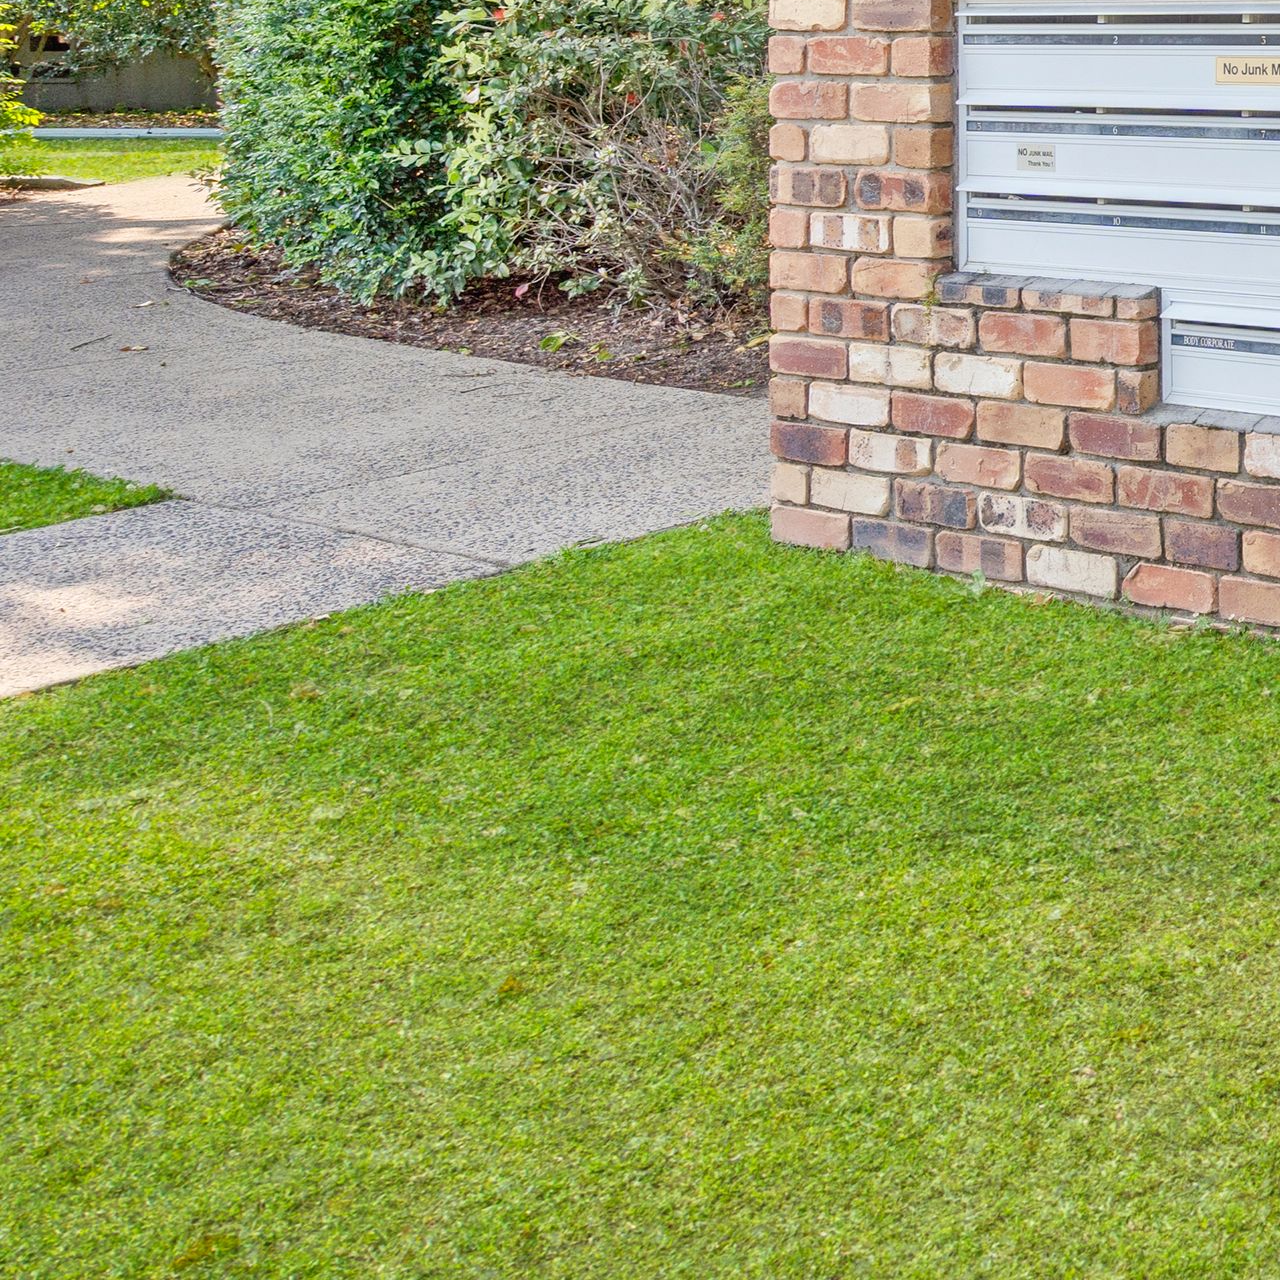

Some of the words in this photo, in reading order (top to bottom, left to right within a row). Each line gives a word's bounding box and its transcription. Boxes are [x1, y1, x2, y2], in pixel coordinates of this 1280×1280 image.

[1112, 35, 1119, 45] 2
[1260, 35, 1267, 45] 3
[1223, 62, 1239, 75] No
[1241, 62, 1268, 76] Junk
[1112, 127, 1118, 135] 6
[1260, 130, 1266, 139] 7
[1017, 148, 1028, 156] NO
[977, 209, 983, 217] 9
[1112, 216, 1121, 226] 10
[1260, 225, 1266, 234] 11
[1183, 335, 1200, 346] BODY
[1200, 337, 1235, 350] CORPORATE
